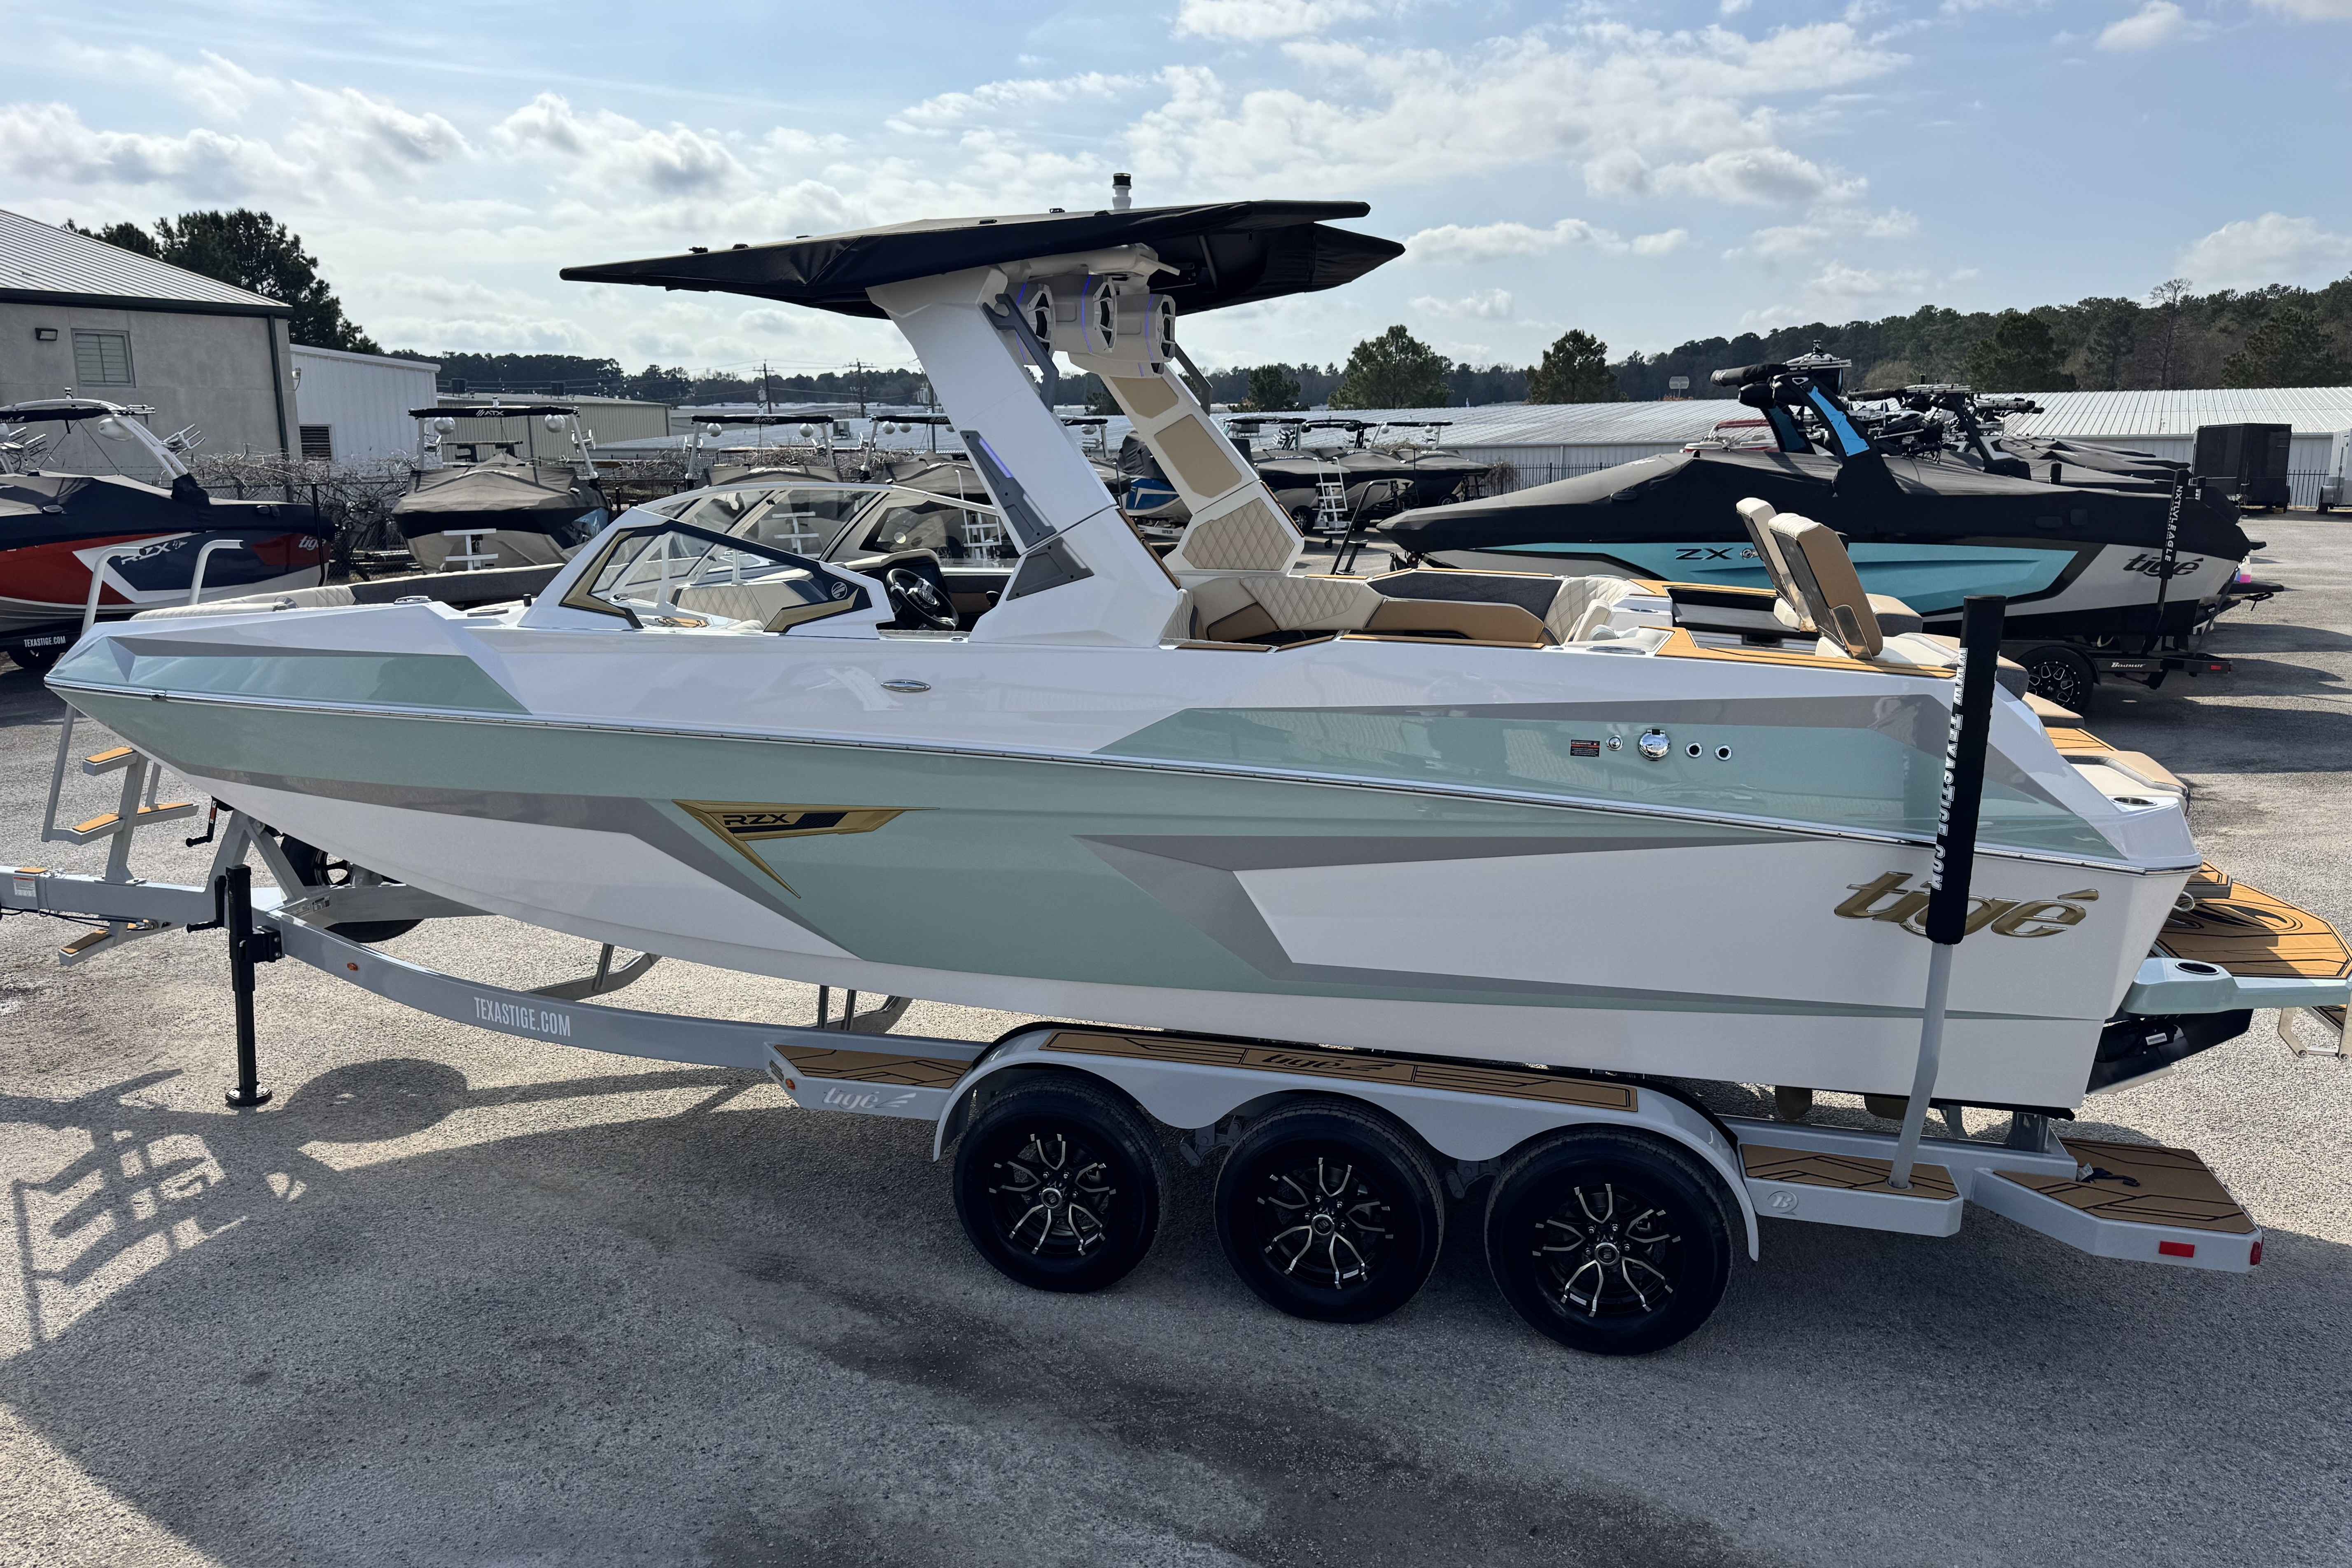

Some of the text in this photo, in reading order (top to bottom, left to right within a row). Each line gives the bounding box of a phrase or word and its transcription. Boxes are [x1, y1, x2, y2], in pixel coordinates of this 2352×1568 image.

[1675, 547, 1734, 560] ZX
[23, 635, 66, 648] TEXASTIGE.COM
[722, 813, 791, 826] RZX
[474, 996, 571, 1037] TEXASTIGE.COM
